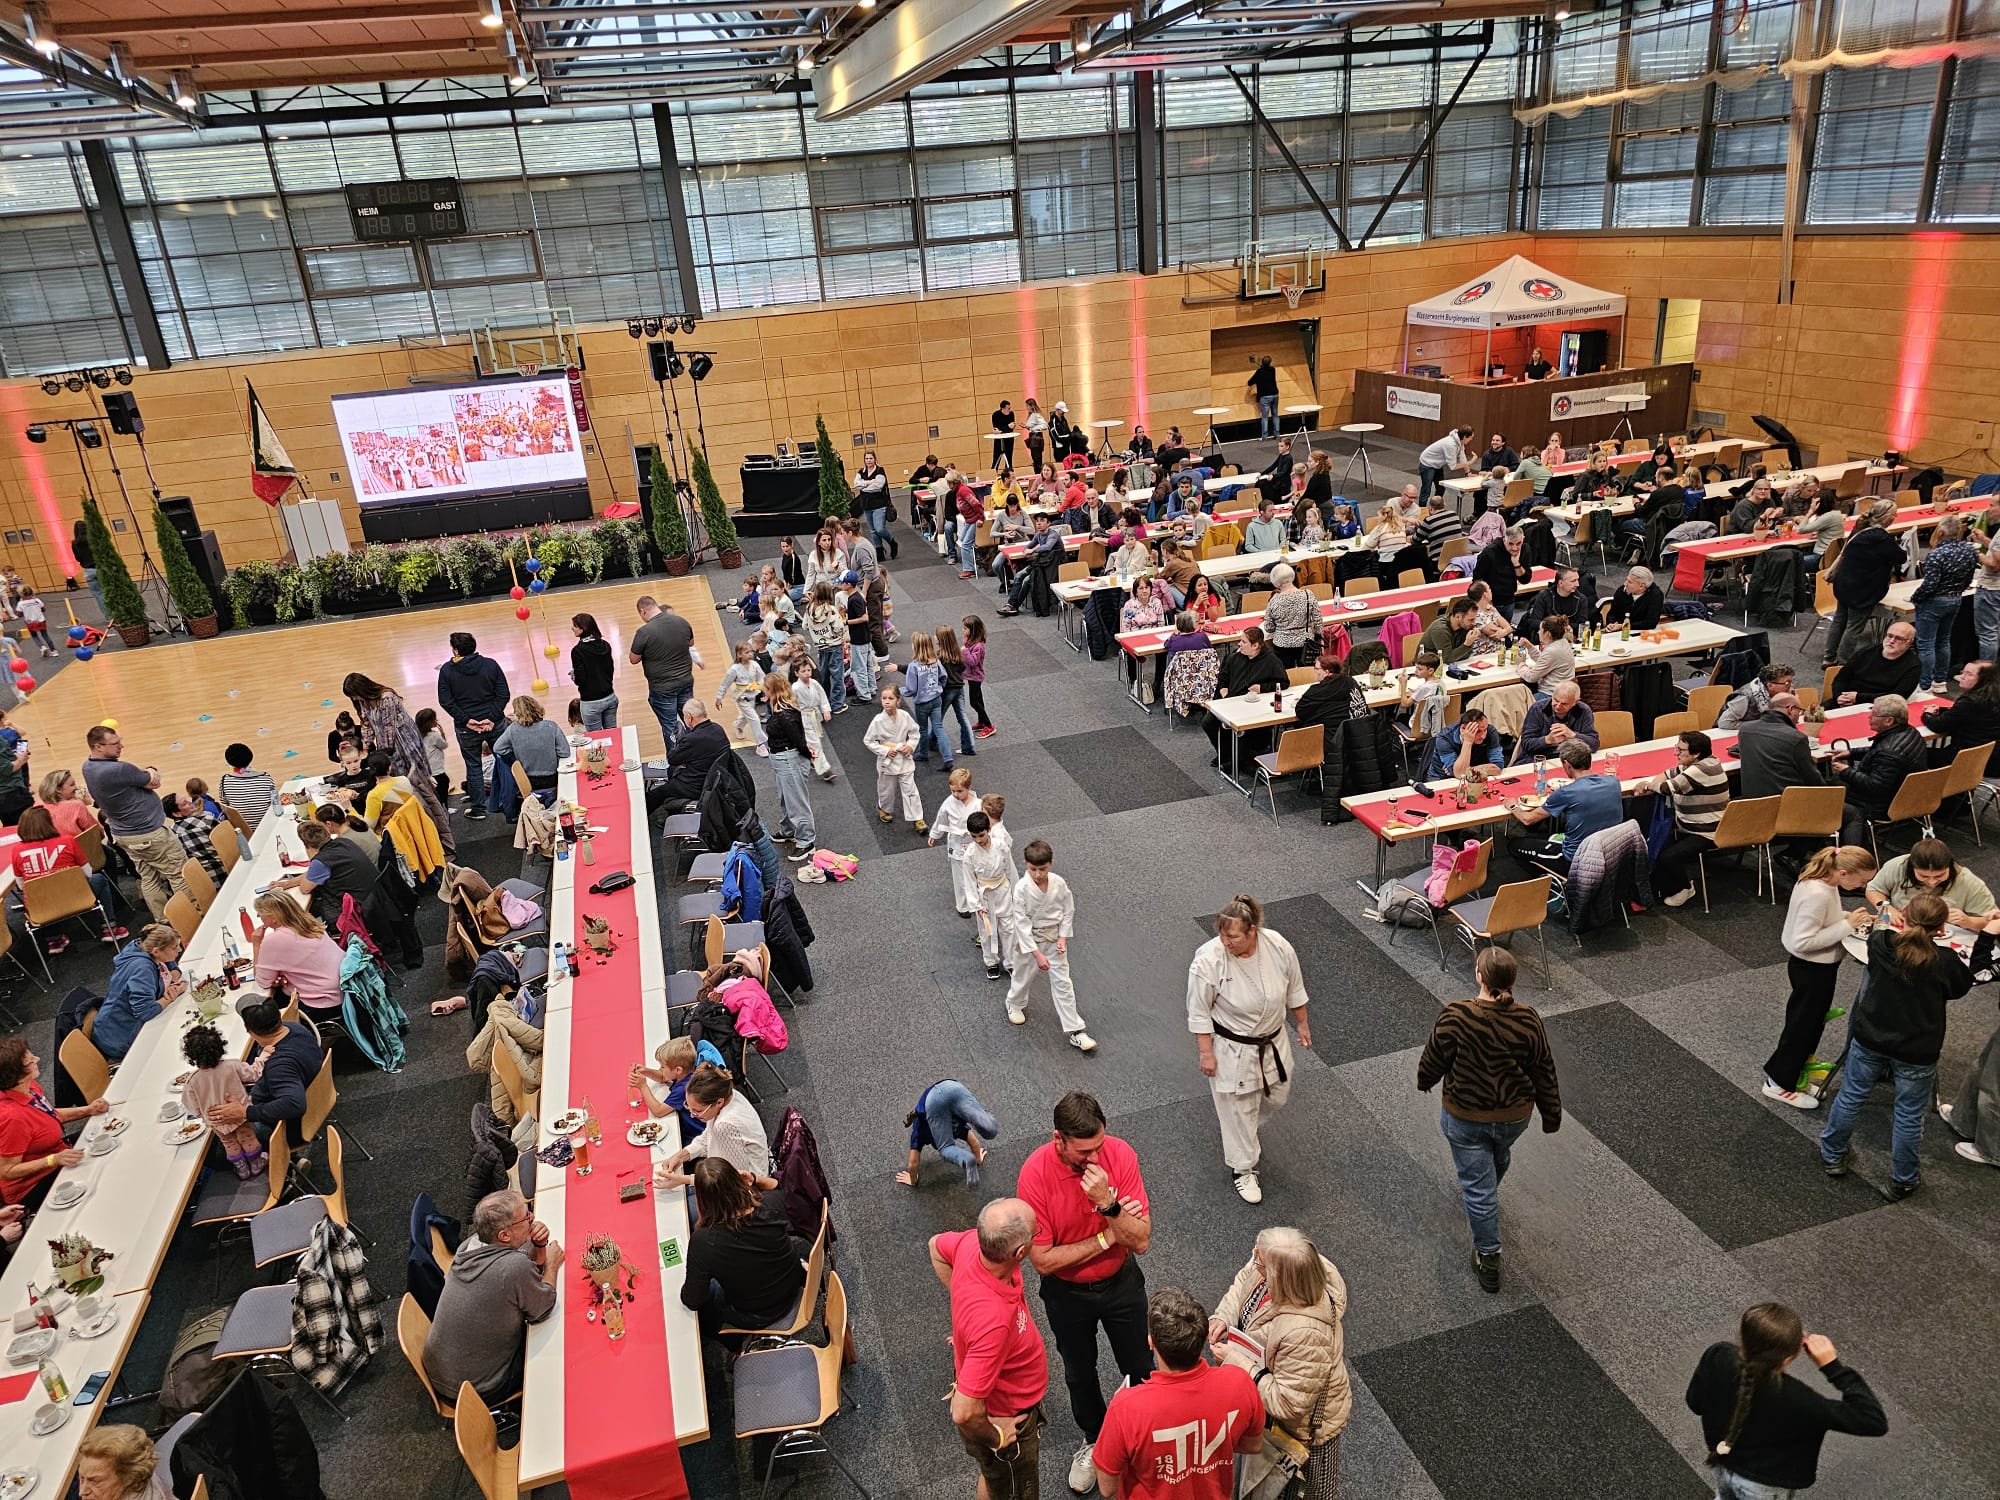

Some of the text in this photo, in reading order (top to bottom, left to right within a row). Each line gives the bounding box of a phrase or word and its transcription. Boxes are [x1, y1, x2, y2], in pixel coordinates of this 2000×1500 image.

[357, 207, 379, 216] HEIM
[433, 201, 457, 211] GAST
[1416, 311, 1480, 323] Wasserwacht Burglengenfeld
[1507, 303, 1611, 321] Wasserwacht Burglengenfeld
[19, 844, 67, 873] TV
[663, 1243, 679, 1262] 168
[1152, 1409, 1240, 1474] TV
[1155, 1454, 1174, 1465] 18
[1155, 1464, 1175, 1475] 75
